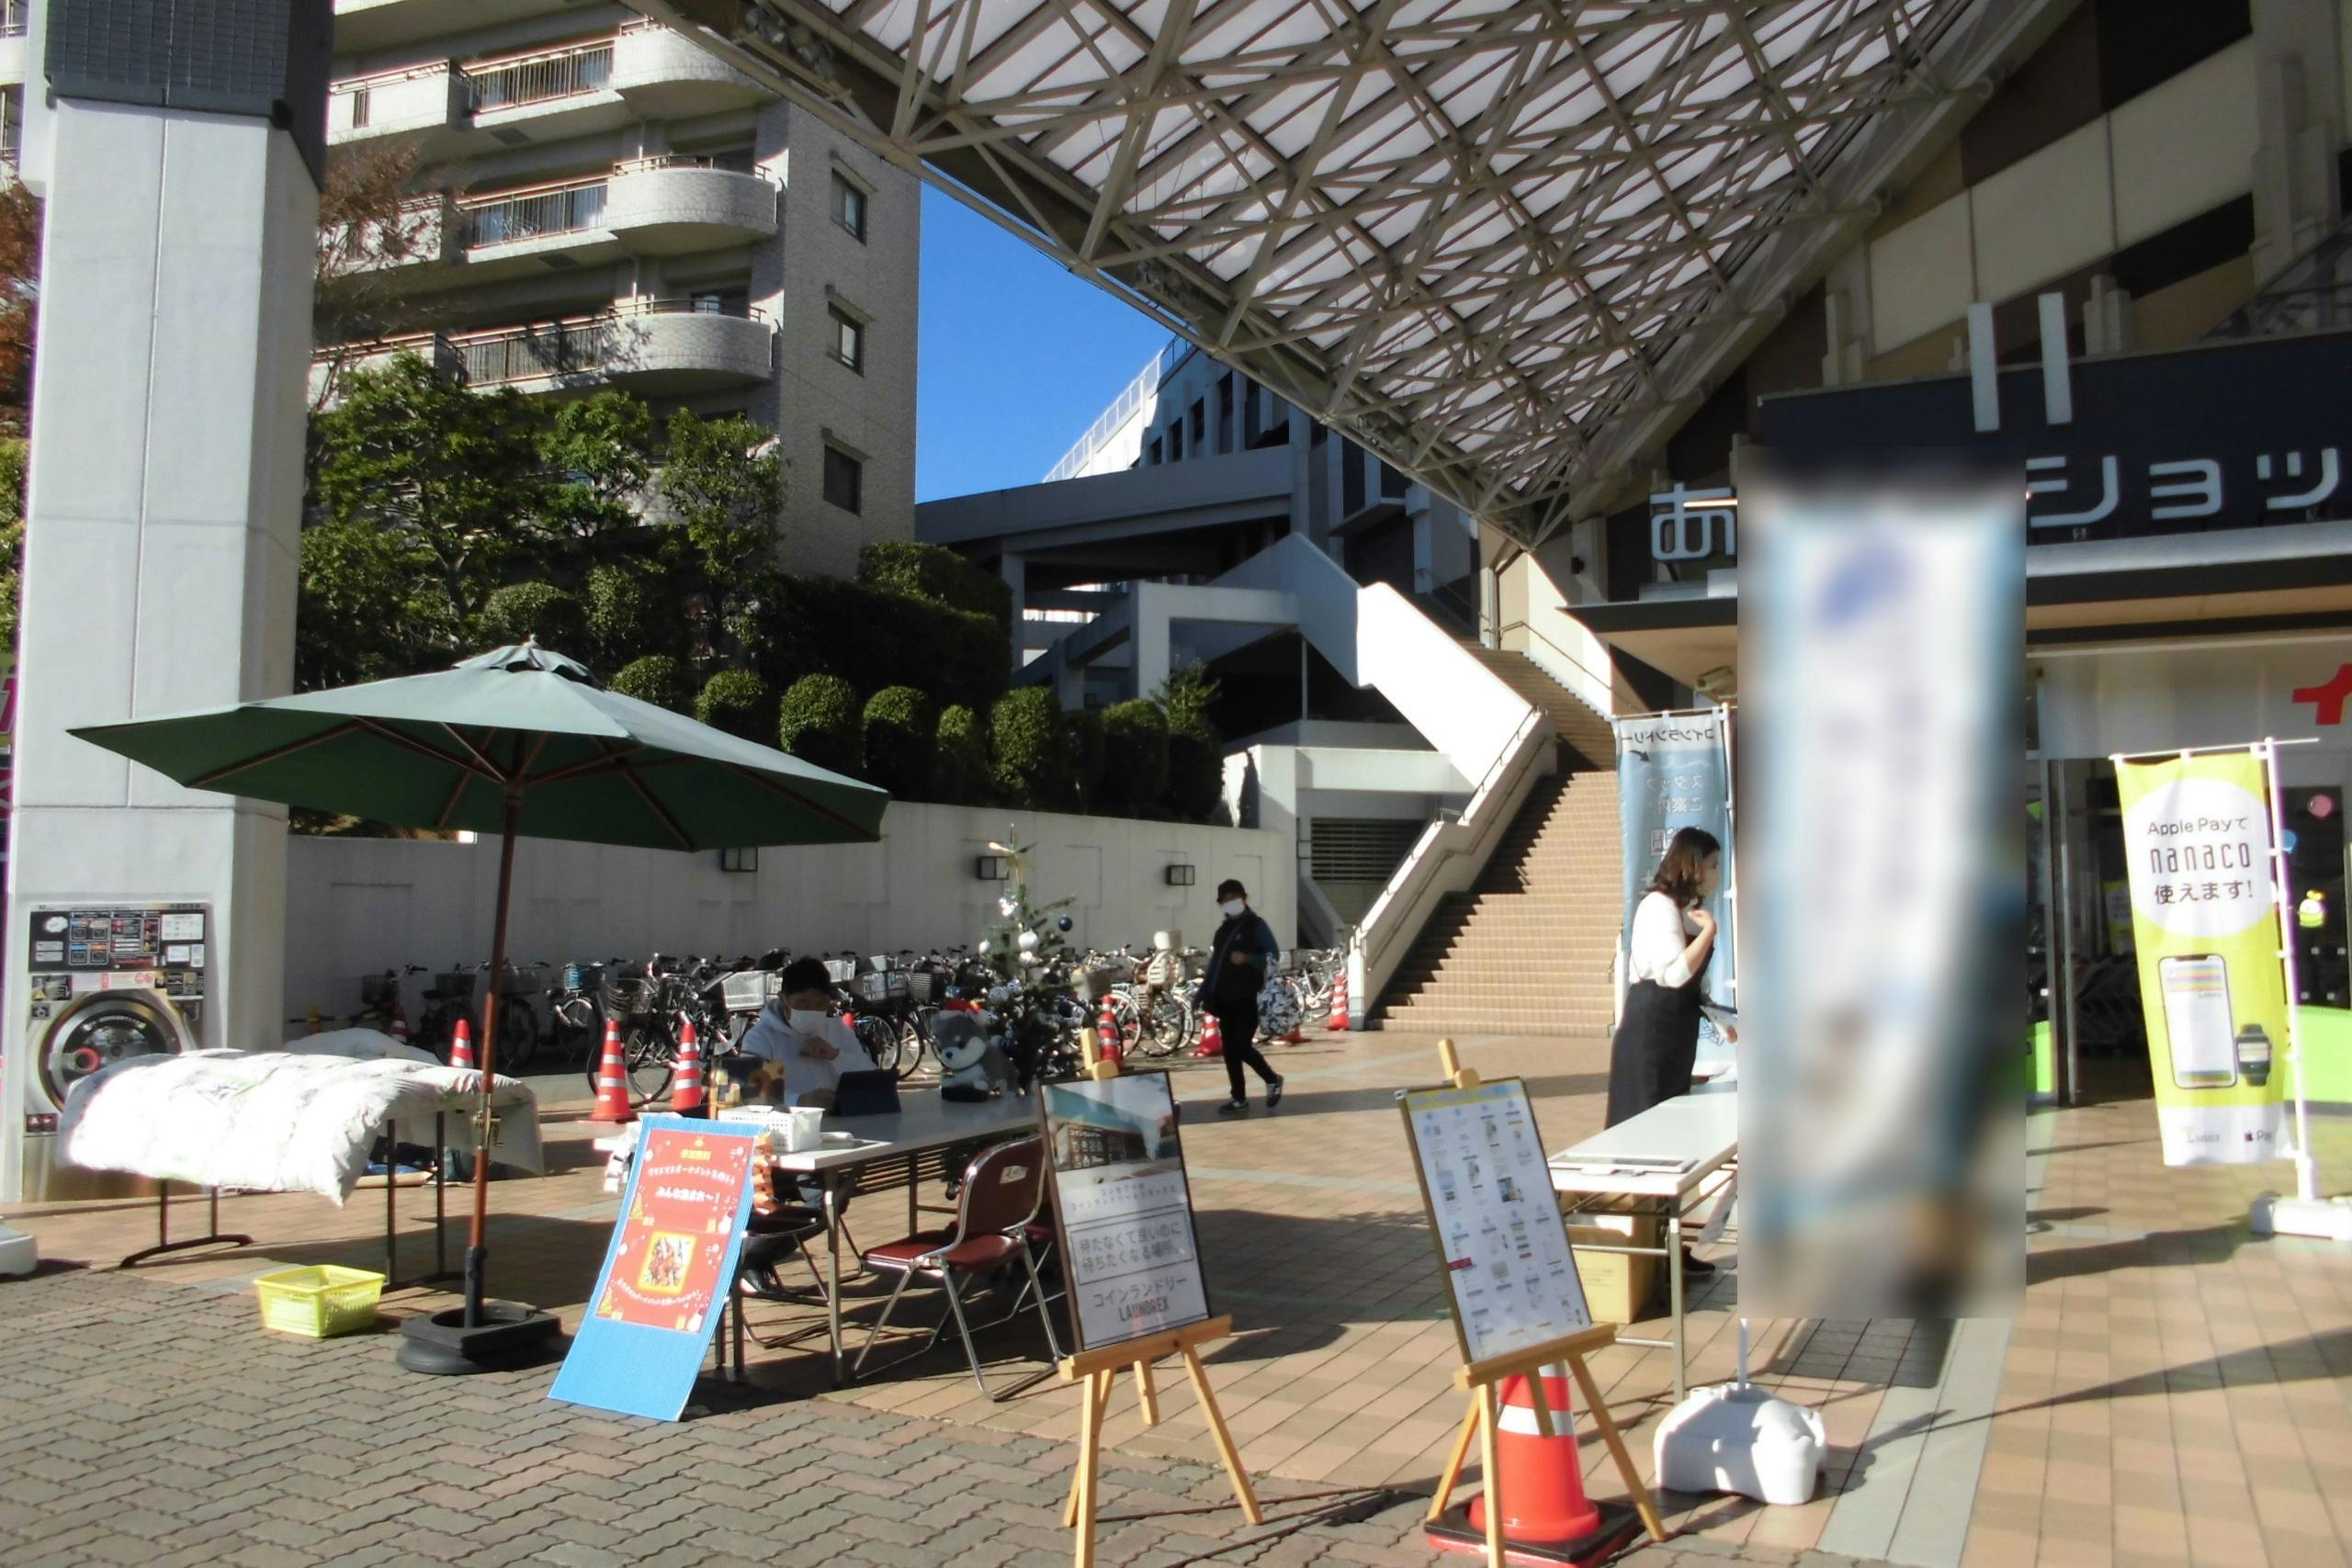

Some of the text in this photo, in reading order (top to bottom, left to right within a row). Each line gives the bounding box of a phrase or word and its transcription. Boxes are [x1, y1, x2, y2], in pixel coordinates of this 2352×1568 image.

[2147, 819, 2194, 837] Apple
[2150, 842, 2251, 874] nanaco
[1092, 1275, 1187, 1308] コインランドリー
[1118, 1295, 1170, 1322] LAUNDREX
